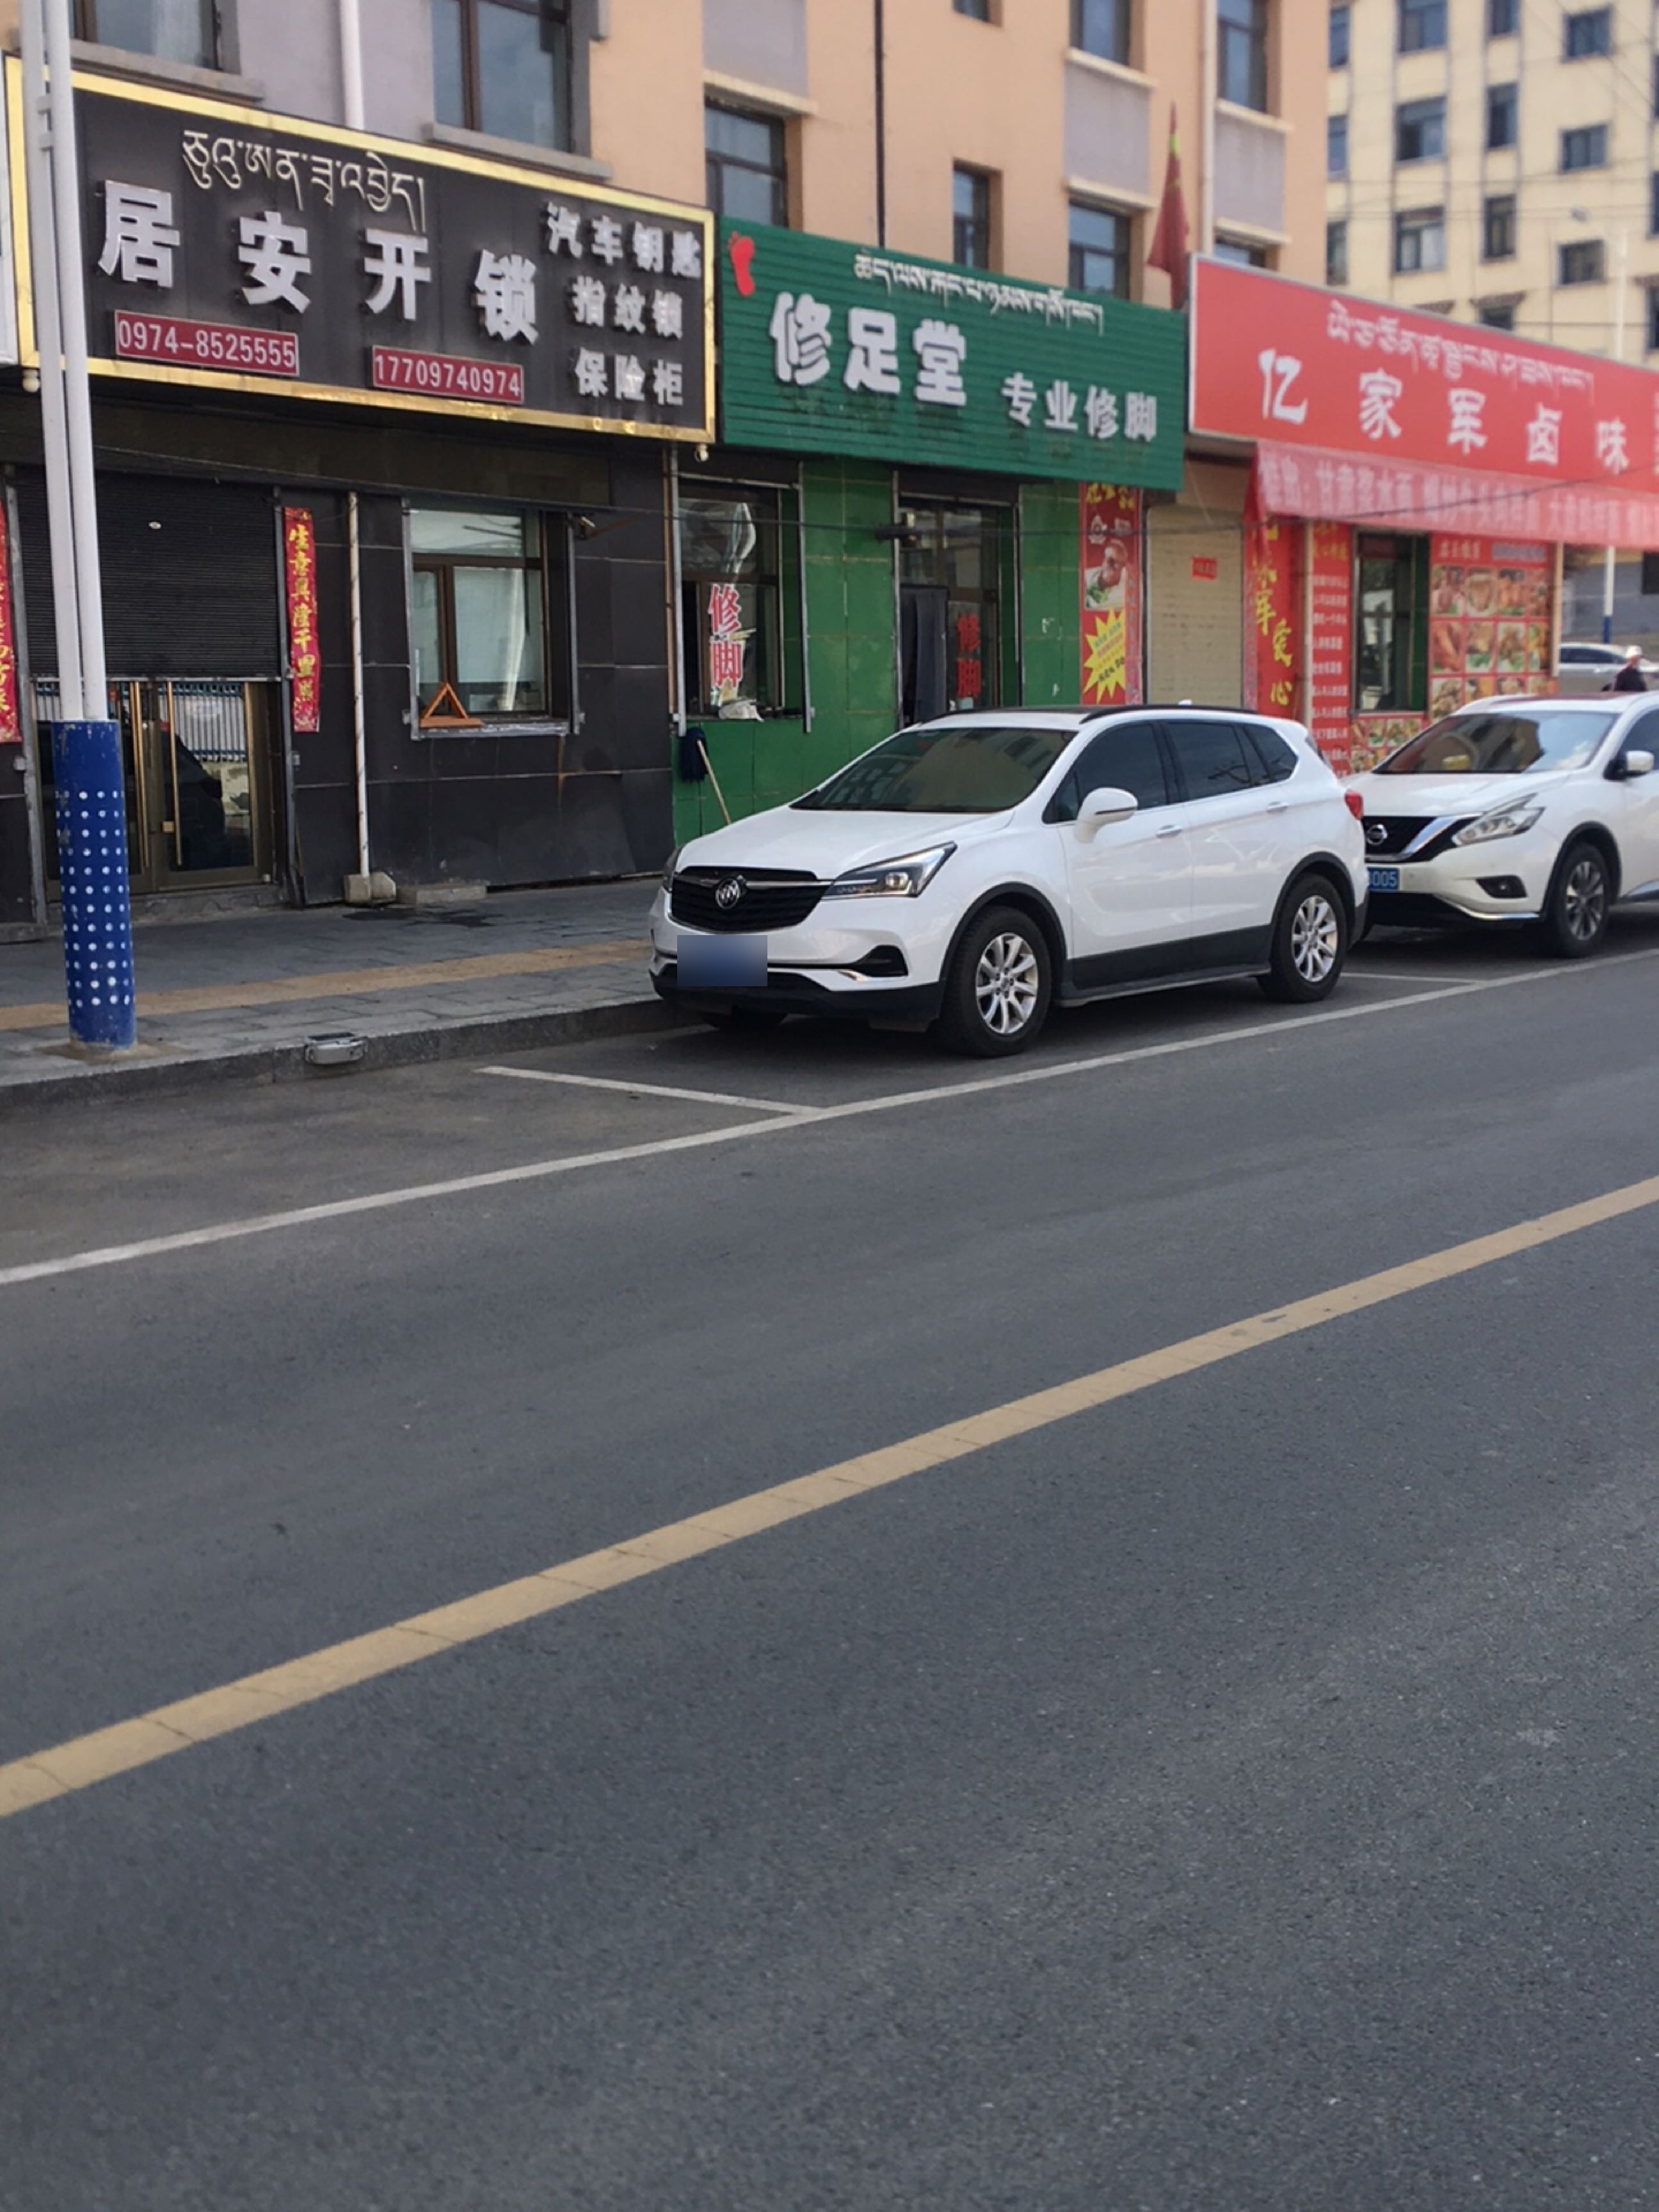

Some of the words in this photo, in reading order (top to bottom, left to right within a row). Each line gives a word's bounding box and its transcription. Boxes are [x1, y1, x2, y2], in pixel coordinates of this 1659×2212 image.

[98, 179, 539, 344] 居安开锁
[547, 201, 702, 279] 汽车钥匙
[572, 274, 683, 341] 指纹锁
[118, 319, 296, 369] 0974-8525555
[374, 355, 521, 395] 17709740974
[575, 346, 684, 406] 保险柜
[770, 291, 966, 406] 修足堂
[1001, 372, 1158, 442] 专业修脚
[1259, 348, 1659, 475] 亿家军卤味
